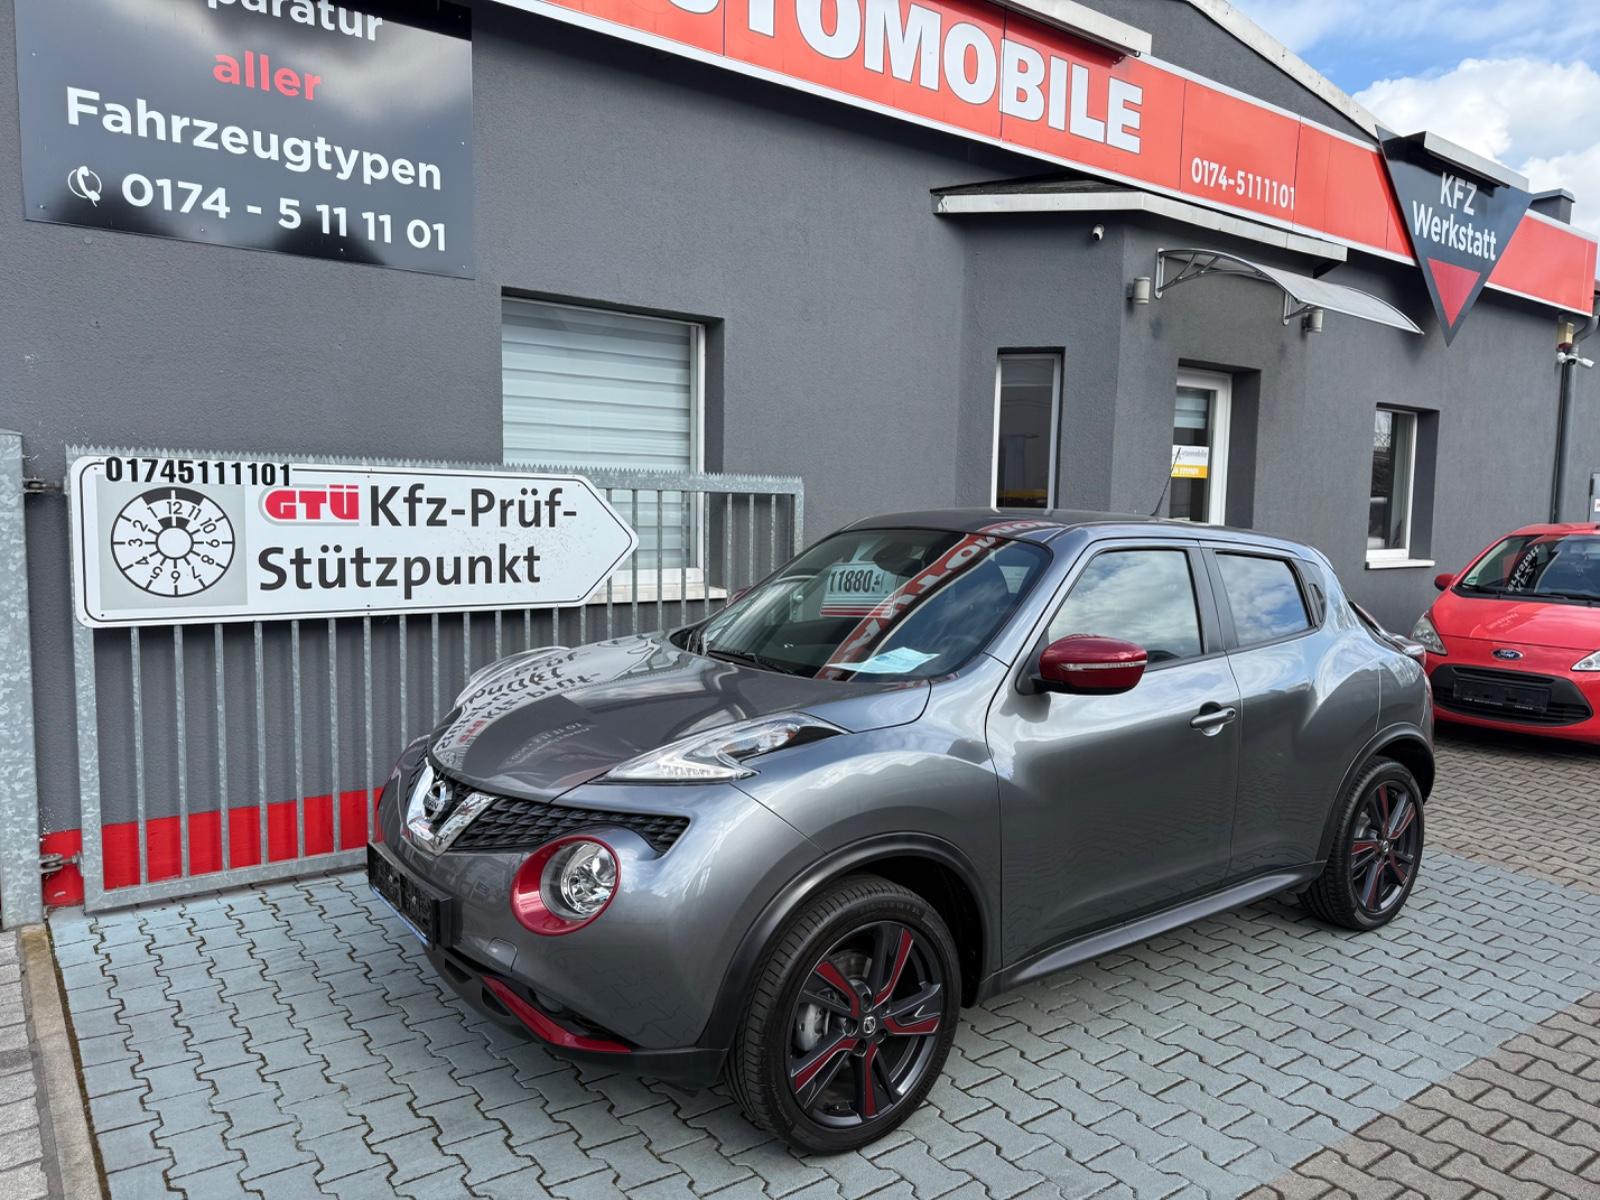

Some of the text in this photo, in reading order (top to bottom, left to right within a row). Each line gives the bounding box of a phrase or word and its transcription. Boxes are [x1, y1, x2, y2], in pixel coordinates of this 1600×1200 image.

[213, 50, 321, 101] aller
[66, 86, 442, 190] Fahrzeugtypen
[1191, 157, 1295, 210] 0174-5111101
[1440, 172, 1477, 216] KFZ
[121, 173, 230, 219] 0174
[278, 197, 301, 229] 5
[315, 204, 347, 237] 11
[361, 211, 392, 244] 11
[406, 219, 446, 251] 01
[1412, 200, 1497, 261] Werkstatt
[105, 456, 290, 486] 01745111101
[265, 483, 577, 528] GTÜ Kfz-Prüf-
[258, 543, 541, 600] Stützpunkt
